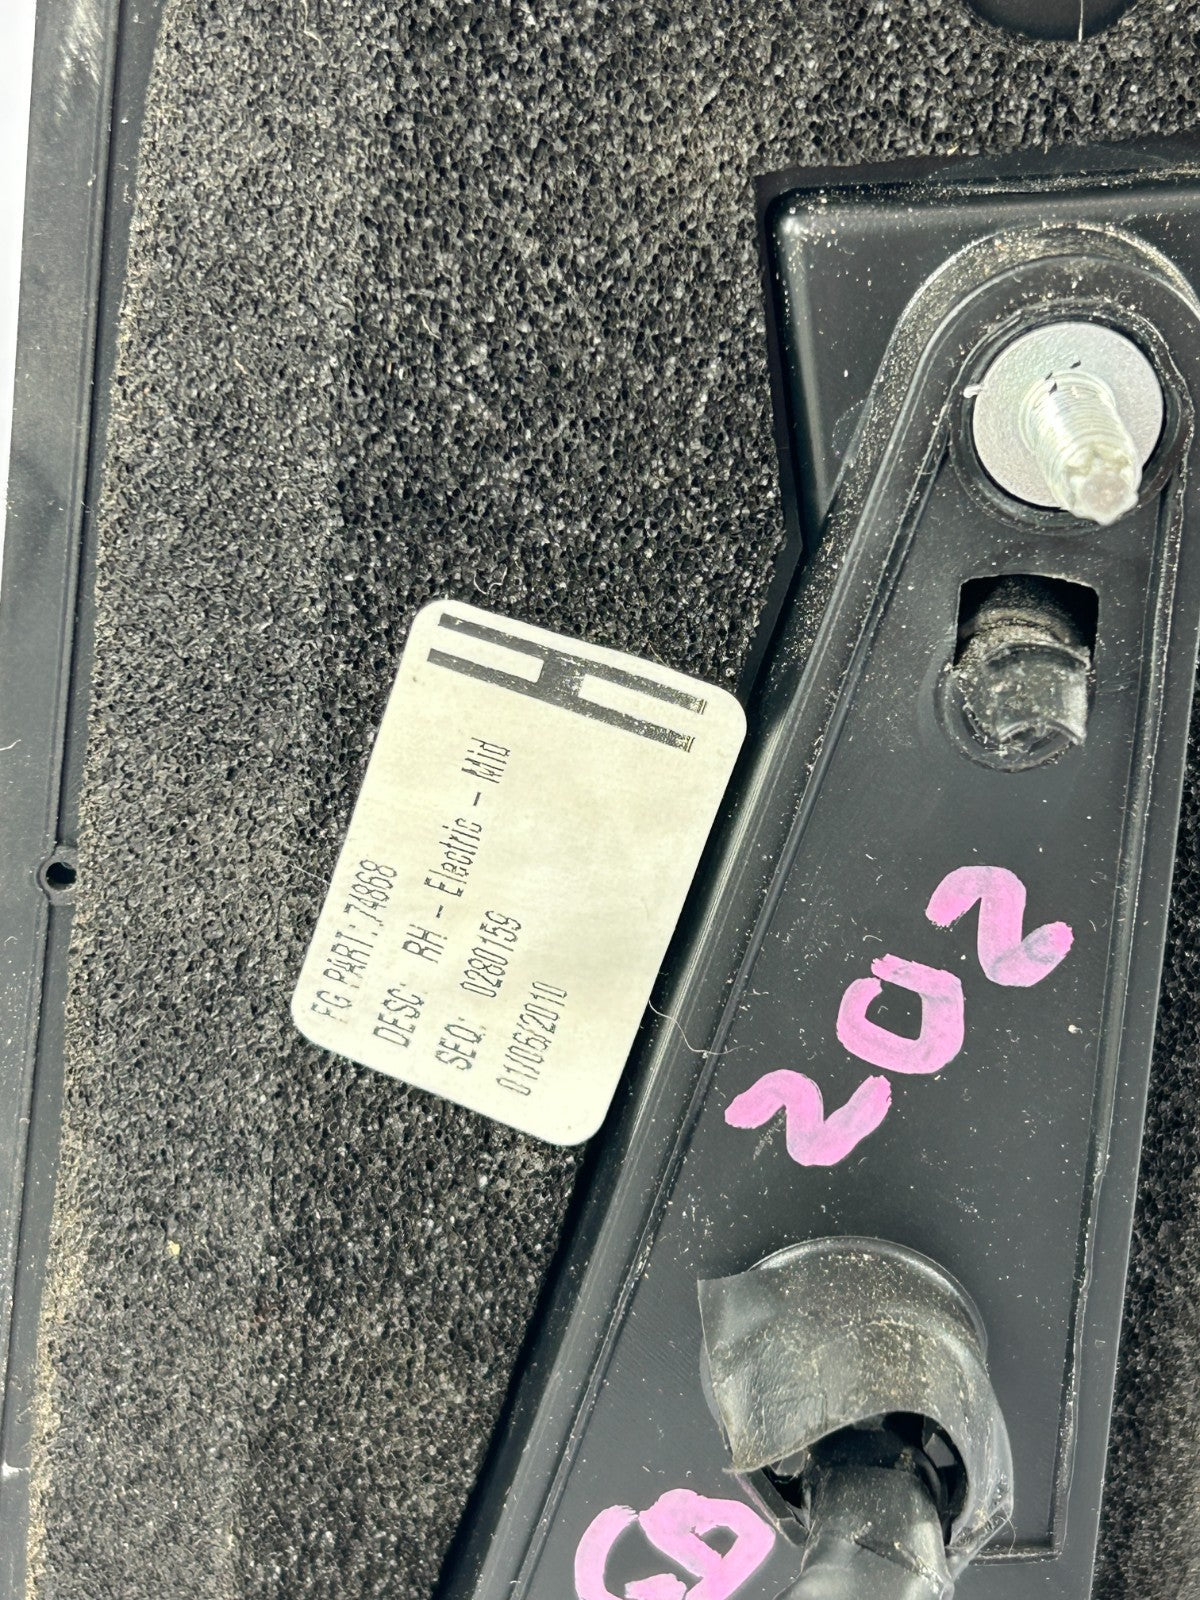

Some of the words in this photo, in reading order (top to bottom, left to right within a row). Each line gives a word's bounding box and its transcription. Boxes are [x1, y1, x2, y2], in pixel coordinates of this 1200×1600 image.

[461, 737, 511, 784] Mid
[424, 817, 483, 898] Electric
[402, 924, 448, 963] RH
[459, 909, 522, 998] 0280159
[311, 989, 353, 1024] FG
[373, 982, 428, 1048] DESC:
[495, 981, 568, 1097] 01/06/2010
[725, 866, 1074, 1166] 202
[436, 1017, 487, 1071] SEQ:
